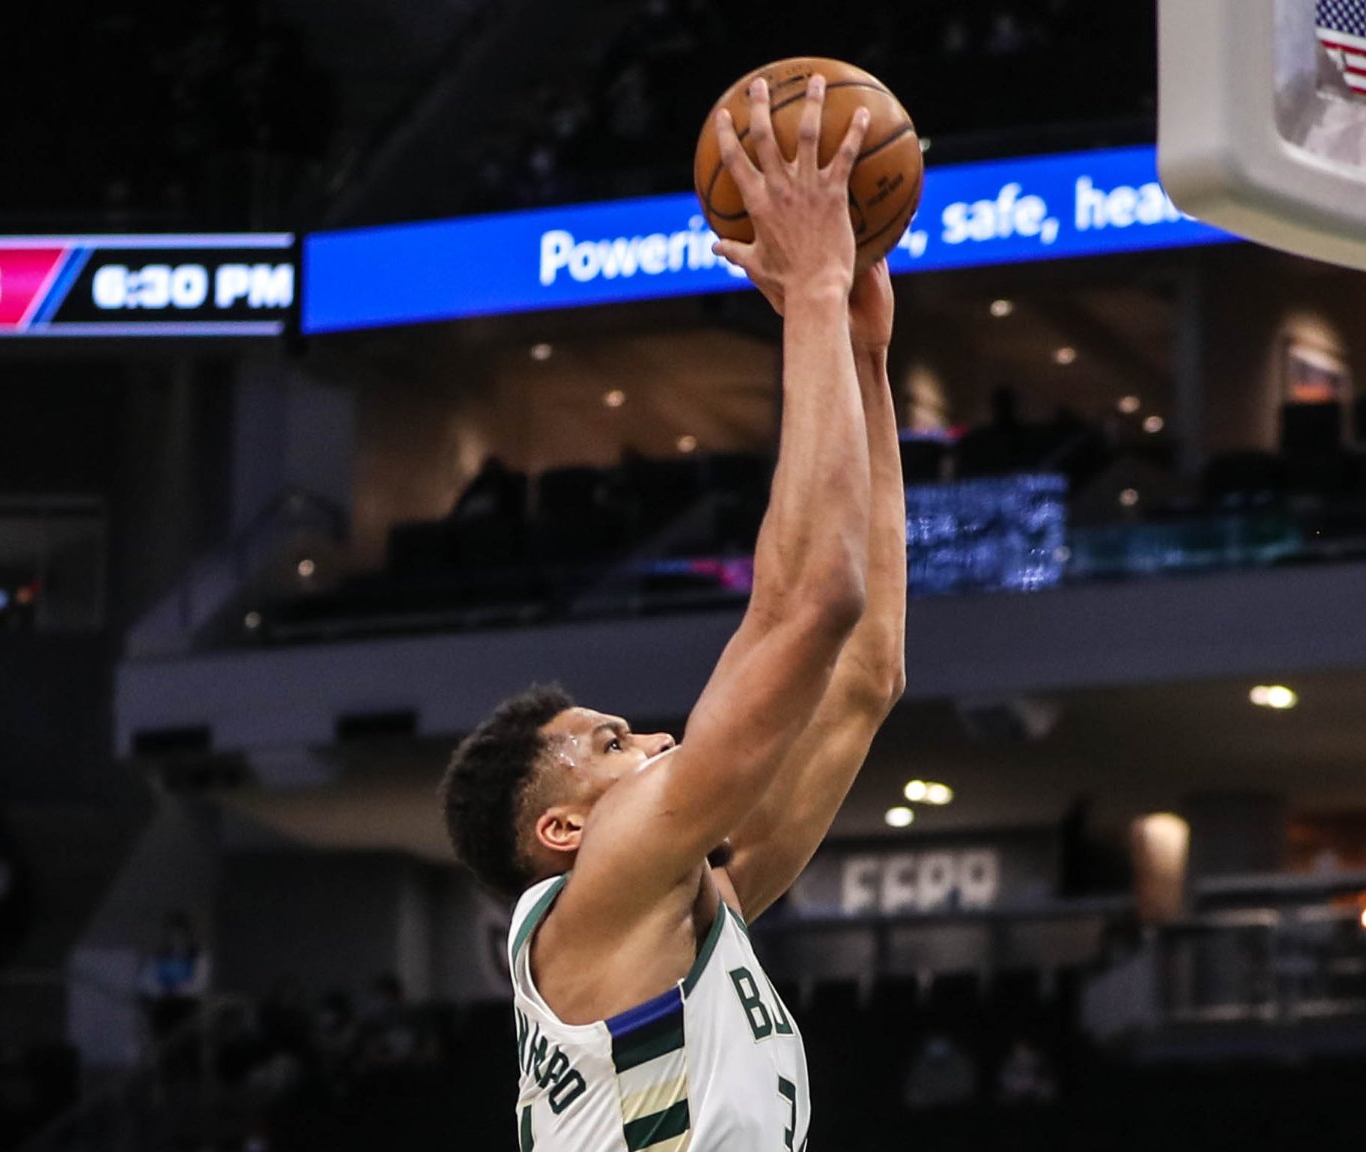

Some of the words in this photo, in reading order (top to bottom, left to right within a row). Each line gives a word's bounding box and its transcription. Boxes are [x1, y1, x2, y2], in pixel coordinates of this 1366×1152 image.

[941, 182, 1059, 245] safe,
[1075, 174, 1193, 232] hea
[214, 264, 295, 309] PM
